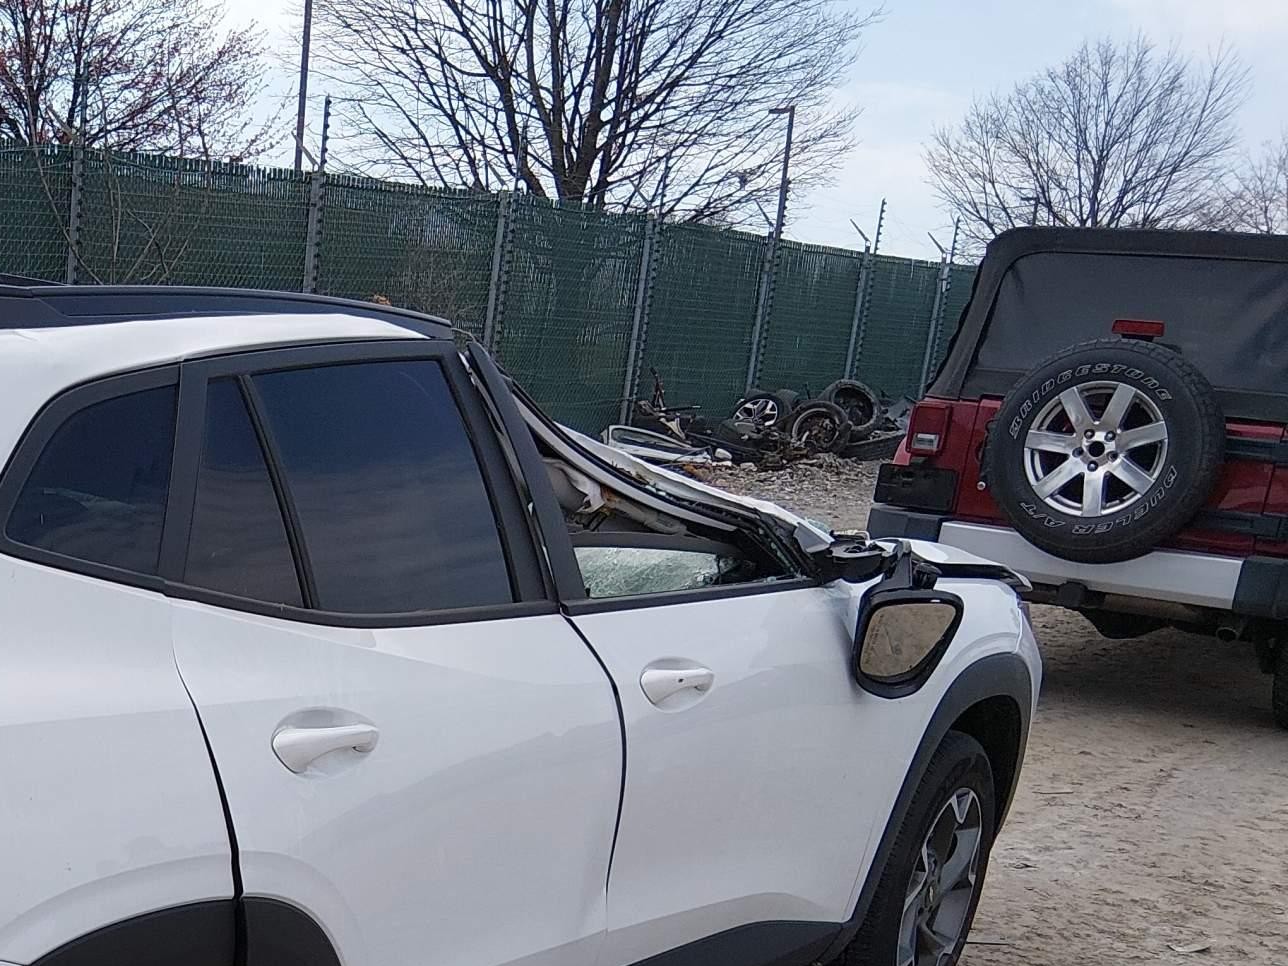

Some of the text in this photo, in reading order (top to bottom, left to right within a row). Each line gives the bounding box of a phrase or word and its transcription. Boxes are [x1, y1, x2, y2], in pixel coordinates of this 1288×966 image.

[1009, 363, 1173, 440] BRIDGESTONE
[1020, 465, 1178, 535] DUELER A/T
